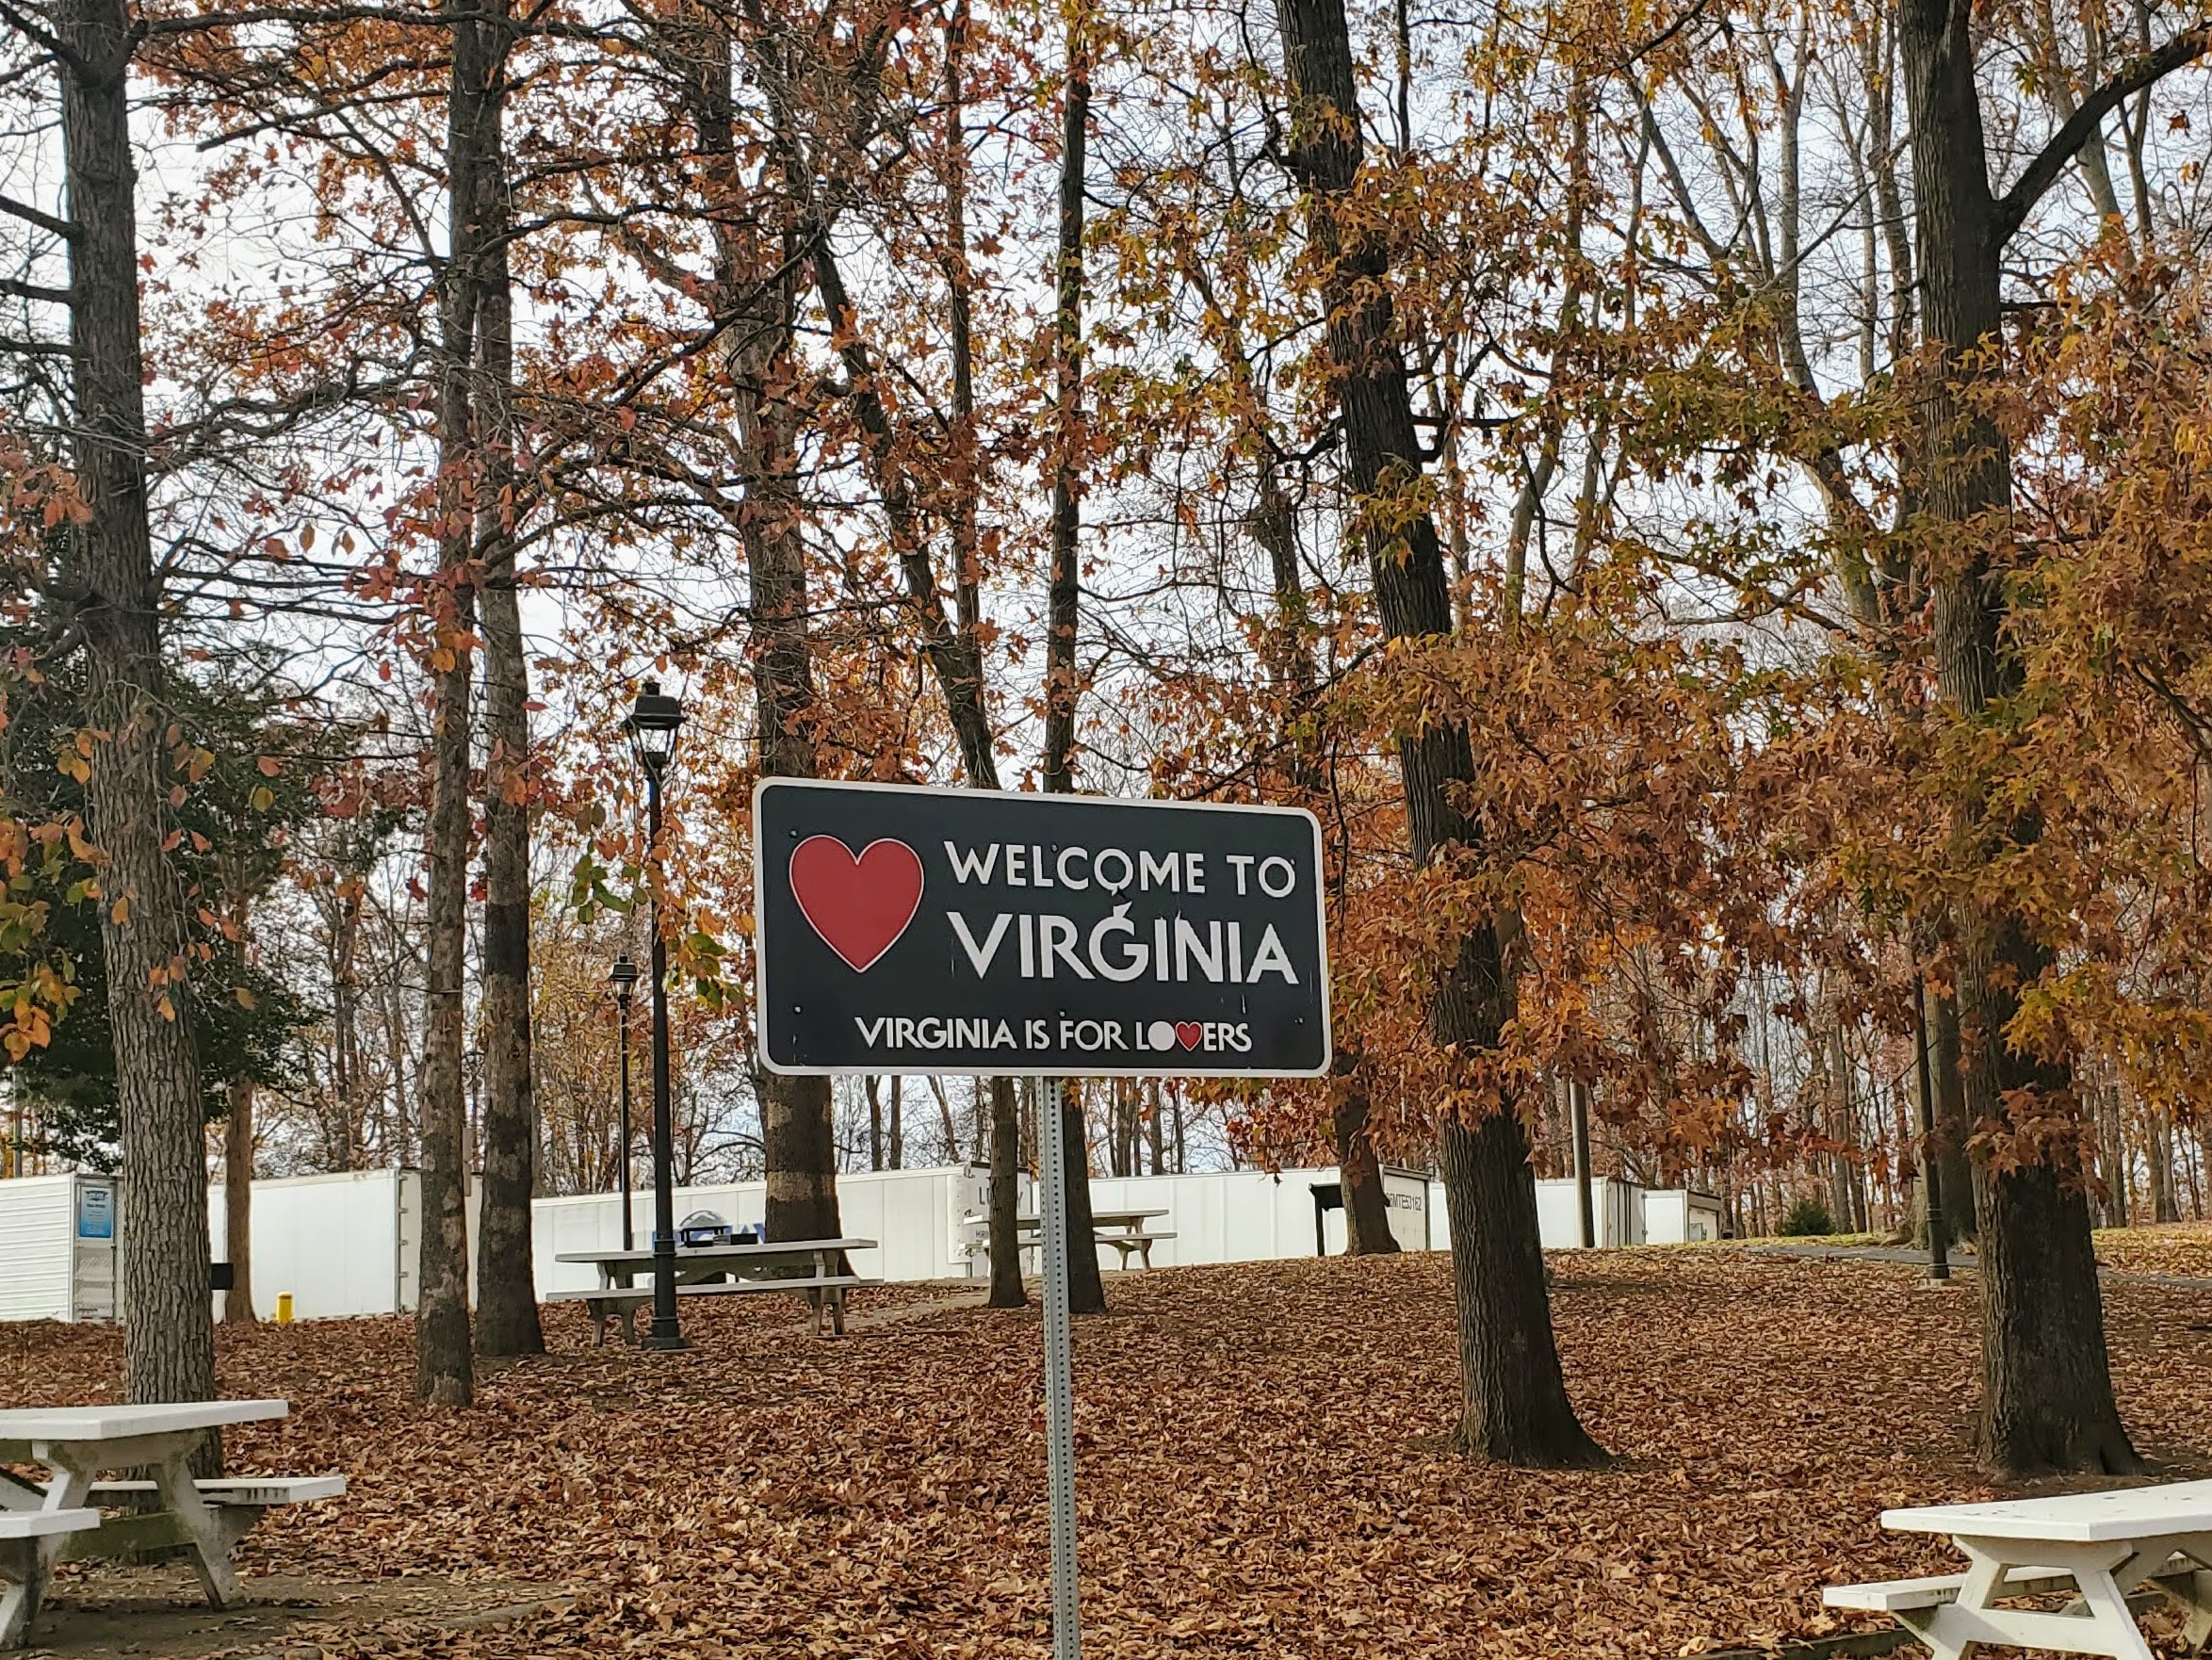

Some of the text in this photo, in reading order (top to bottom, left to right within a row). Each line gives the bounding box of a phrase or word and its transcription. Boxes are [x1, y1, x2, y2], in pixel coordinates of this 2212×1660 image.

[943, 840, 1296, 899] WELCOME TO
[946, 910, 1300, 985] VIRGINIA
[854, 1017, 1017, 1050] VIRGINIA
[1025, 1019, 1050, 1050] IS
[1060, 1019, 1130, 1051] FOR
